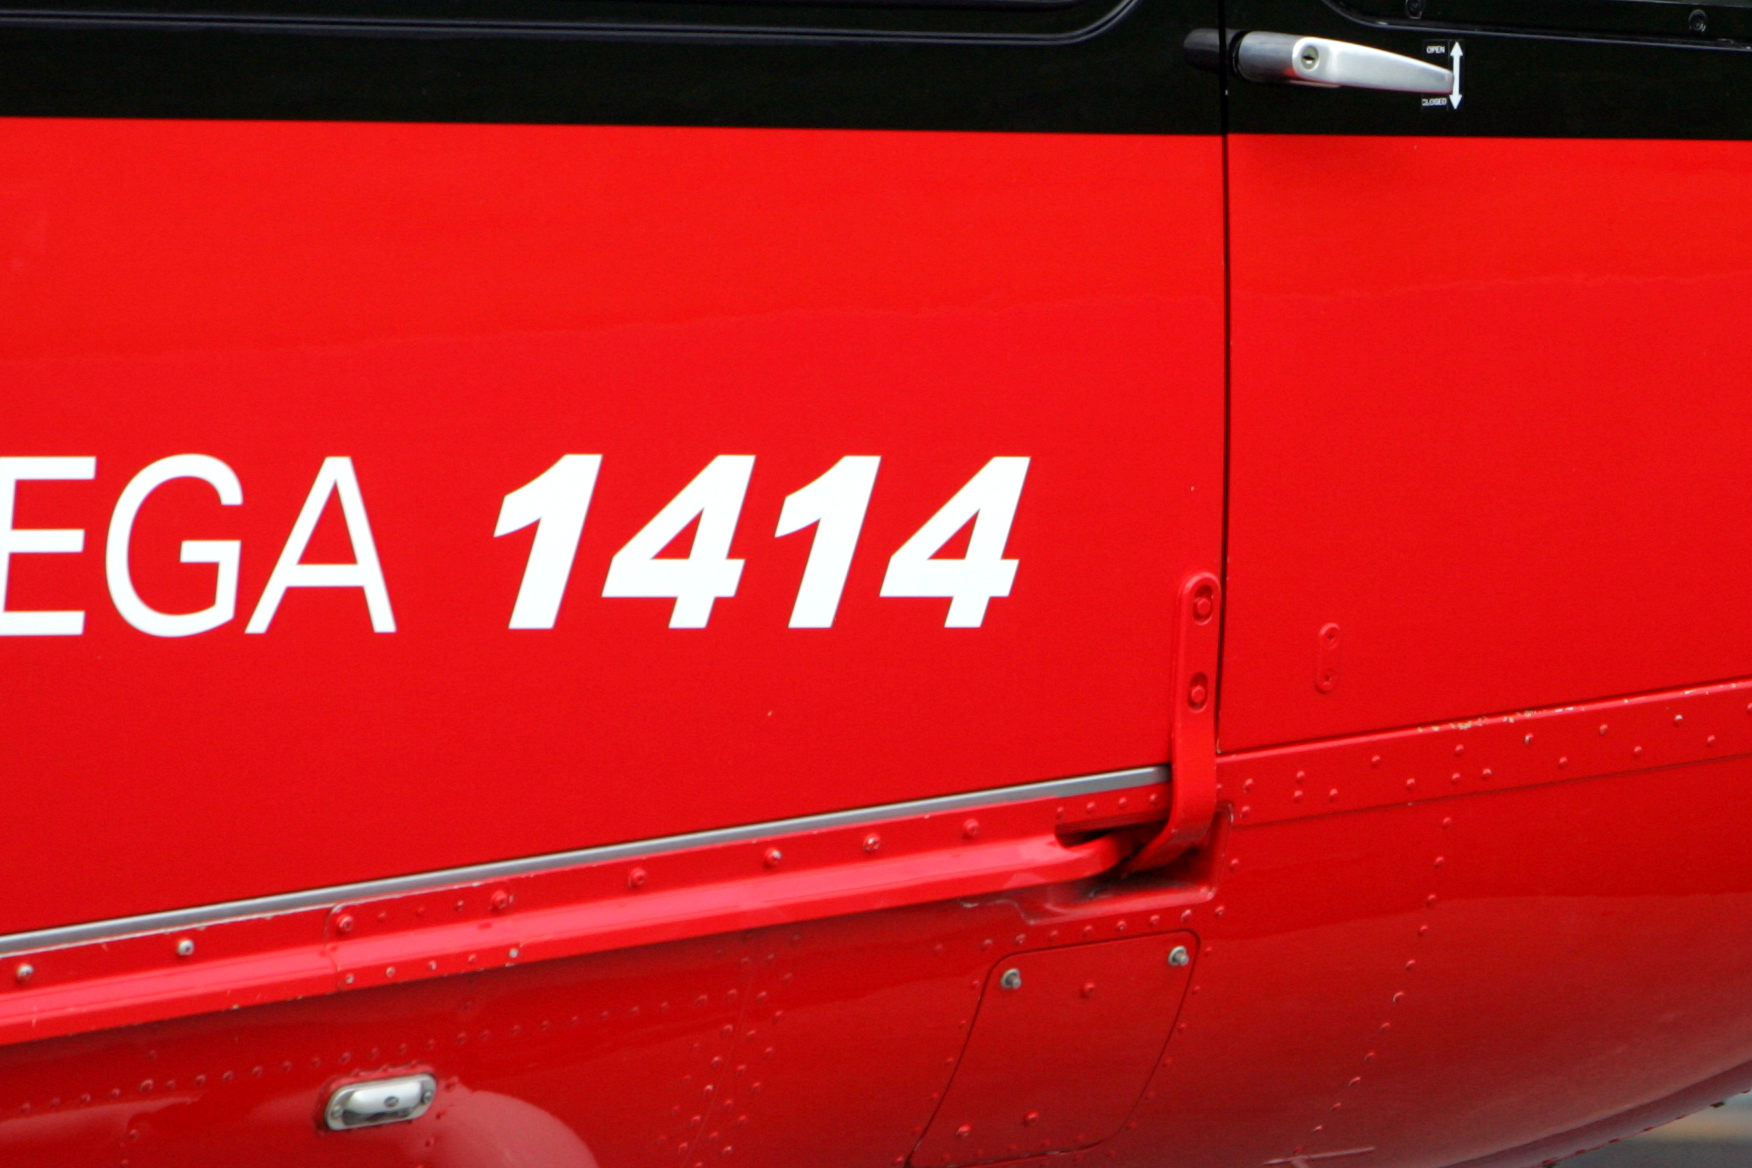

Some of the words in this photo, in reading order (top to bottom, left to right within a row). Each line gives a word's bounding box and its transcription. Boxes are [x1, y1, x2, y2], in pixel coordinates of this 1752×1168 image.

[1426, 45, 1446, 54] OPEN
[0, 454, 397, 637] EGA
[494, 454, 1032, 630] 1414
